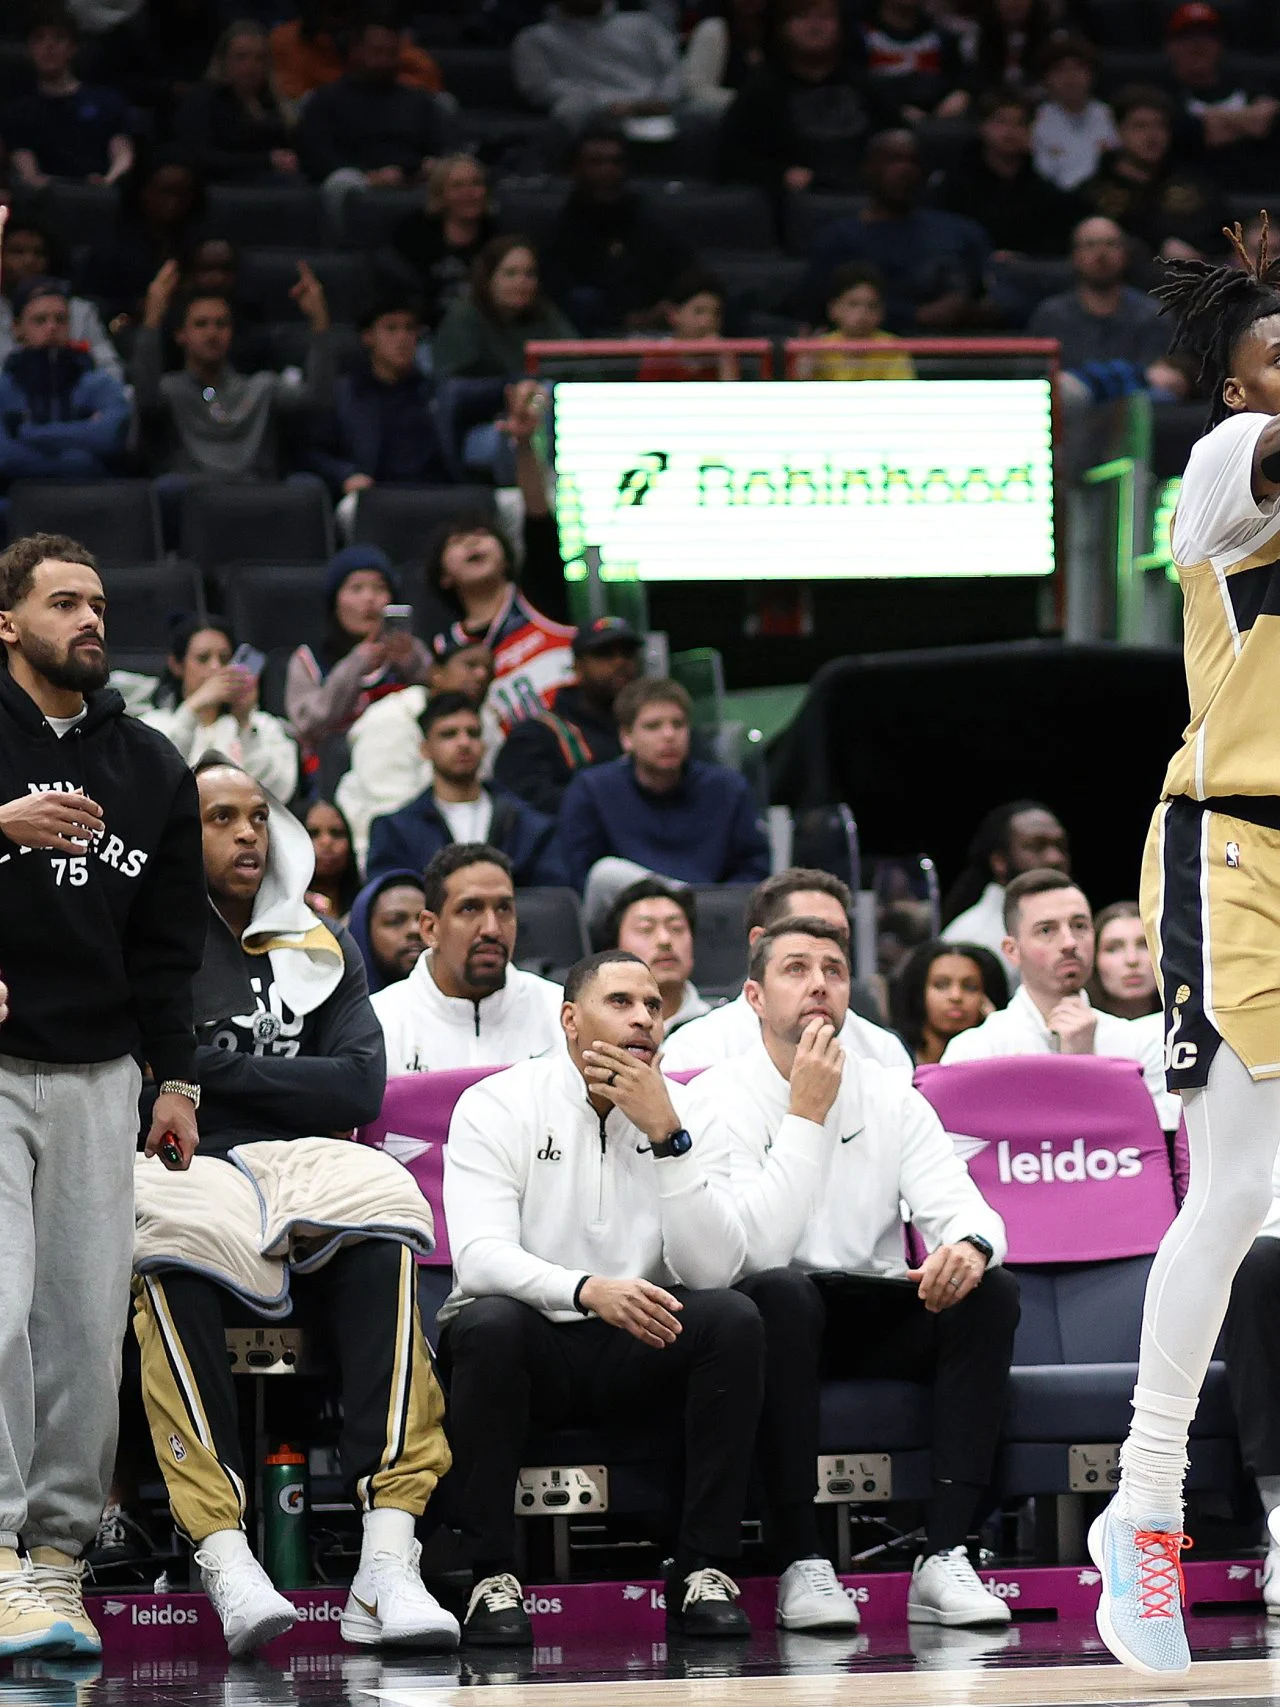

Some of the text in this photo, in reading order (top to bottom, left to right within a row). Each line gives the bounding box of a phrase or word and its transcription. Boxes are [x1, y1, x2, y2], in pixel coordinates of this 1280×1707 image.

[51, 857, 89, 886] 75
[537, 1135, 561, 1160] dc
[998, 1138, 1143, 1184] leidos
[132, 1604, 198, 1625] leidos
[292, 1601, 342, 1621] eido
[523, 1593, 562, 1614] dos
